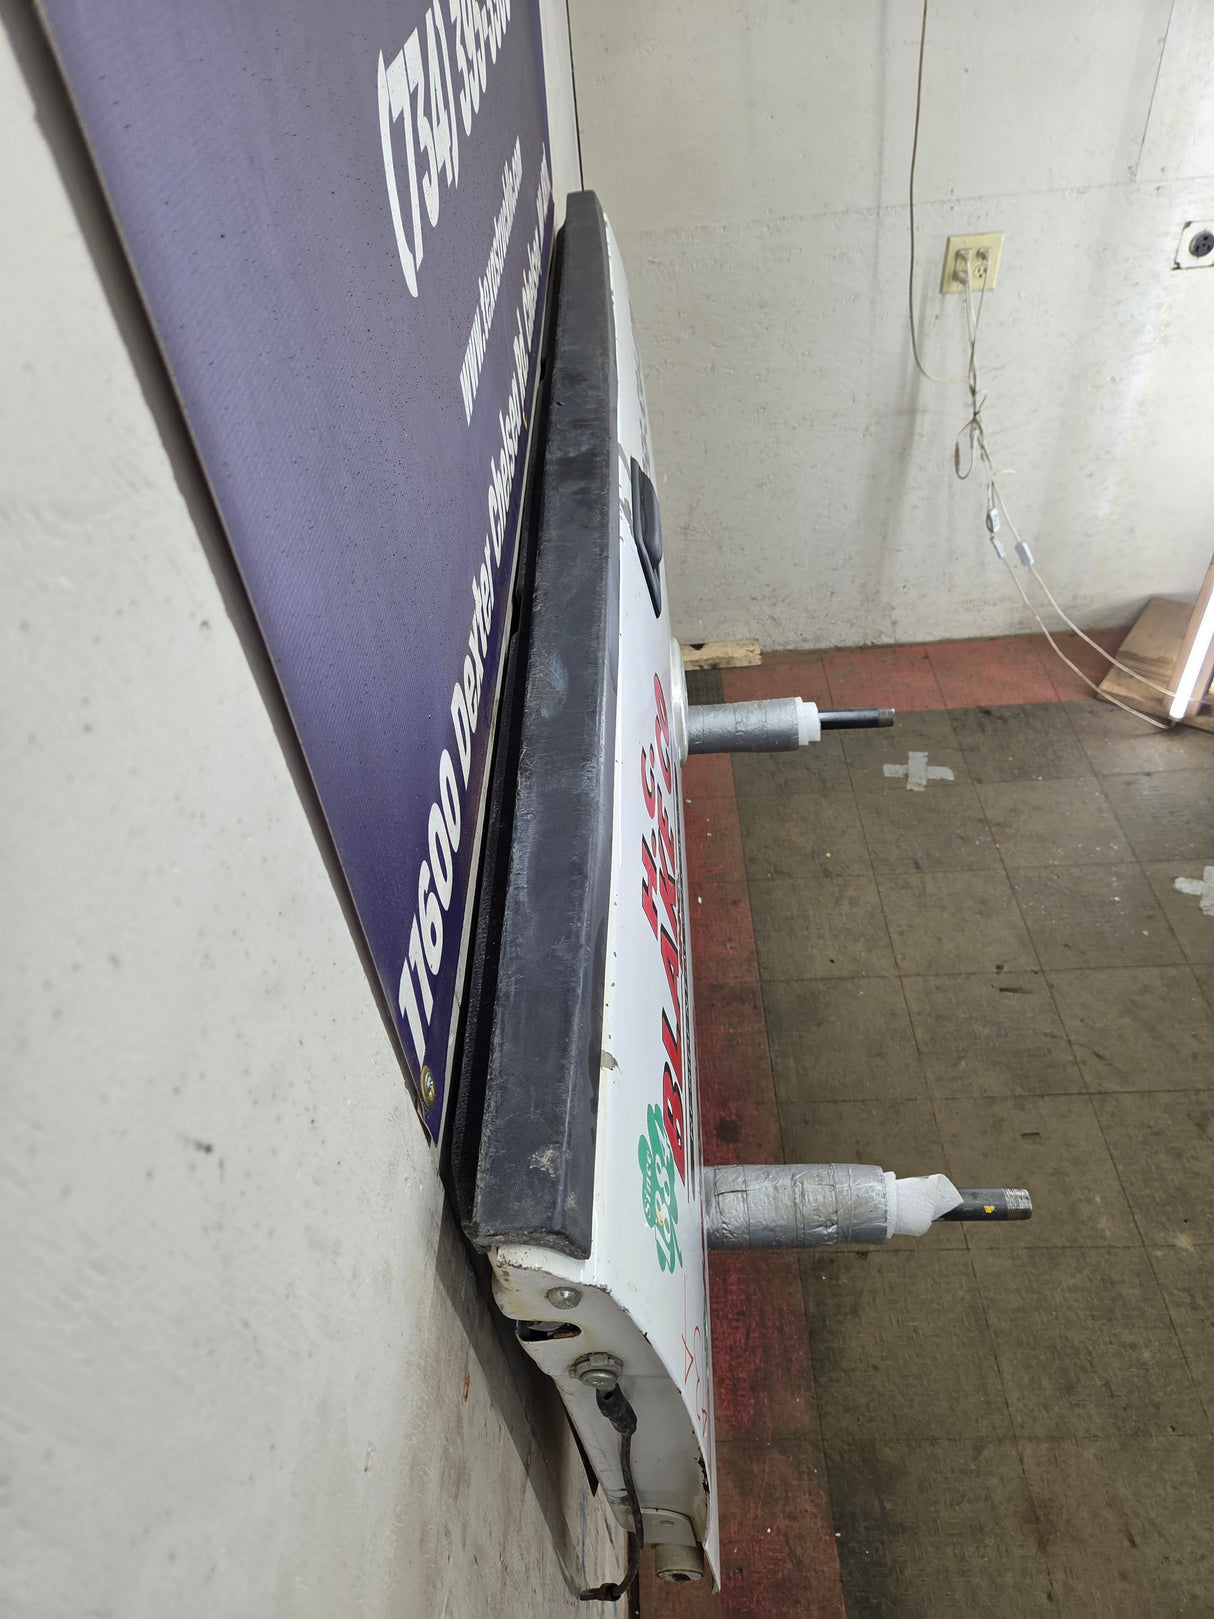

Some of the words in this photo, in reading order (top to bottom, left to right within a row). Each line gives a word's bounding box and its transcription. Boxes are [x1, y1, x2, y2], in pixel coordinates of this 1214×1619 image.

[378, 0, 458, 297] (734)
[399, 748, 461, 1070] 11600
[451, 533, 494, 791] Dexter
[488, 368, 524, 568] Chelsea
[653, 672, 671, 795] CO
[656, 783, 686, 1187] BLAKE
[644, 1150, 652, 1220] Since
[654, 1119, 671, 1266] 1884
